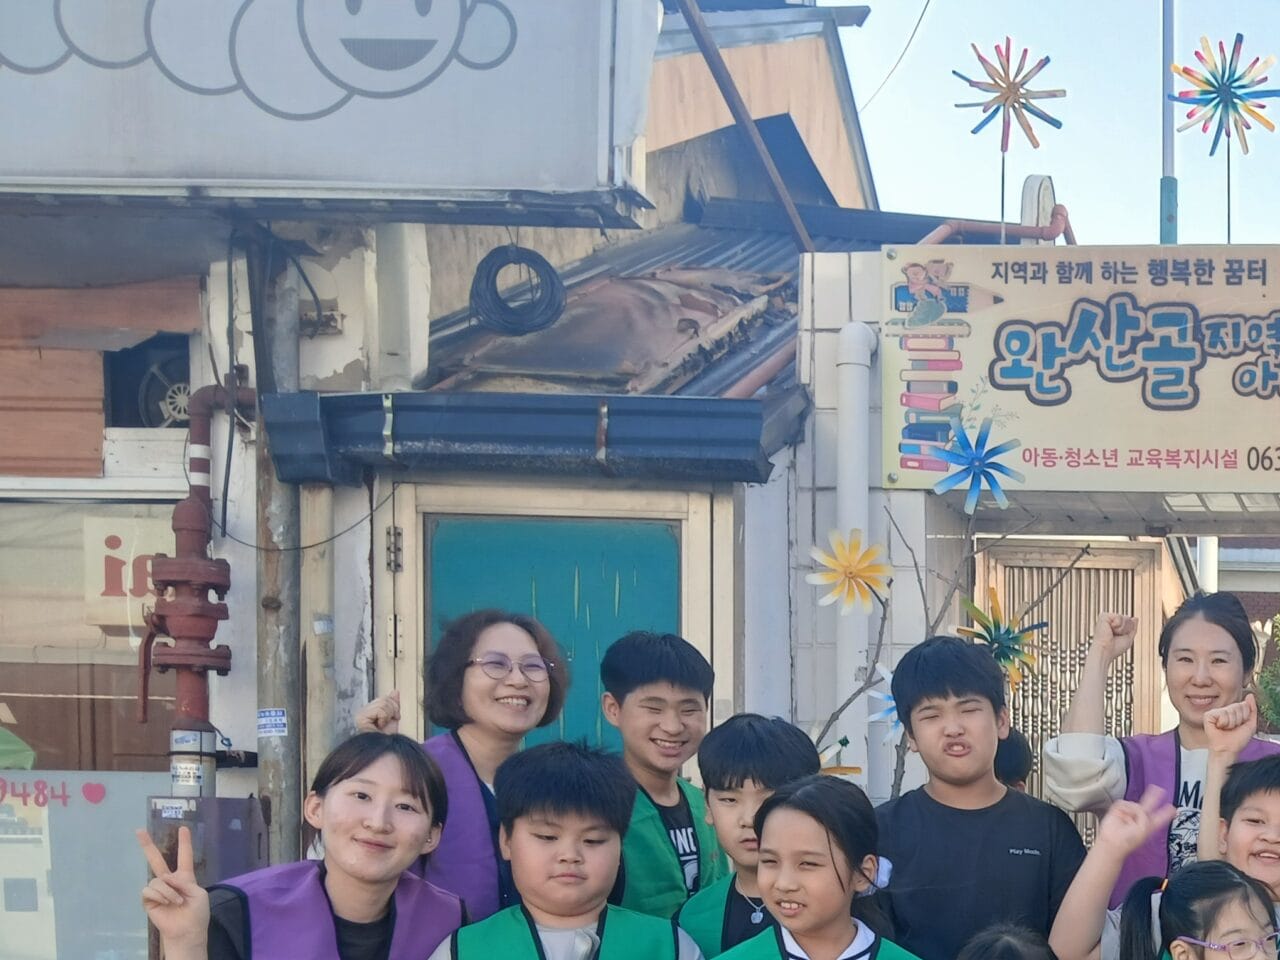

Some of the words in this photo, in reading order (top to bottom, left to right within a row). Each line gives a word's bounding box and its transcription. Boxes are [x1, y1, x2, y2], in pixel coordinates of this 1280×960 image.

[991, 260, 1049, 285] 지역과
[1055, 261, 1094, 285] 함께
[1100, 261, 1139, 285] 하는
[1147, 258, 1216, 287] 행복한
[1223, 258, 1268, 287] 꿈터
[993, 297, 1200, 405] 완산골
[1125, 447, 1239, 470] 교육복지시설
